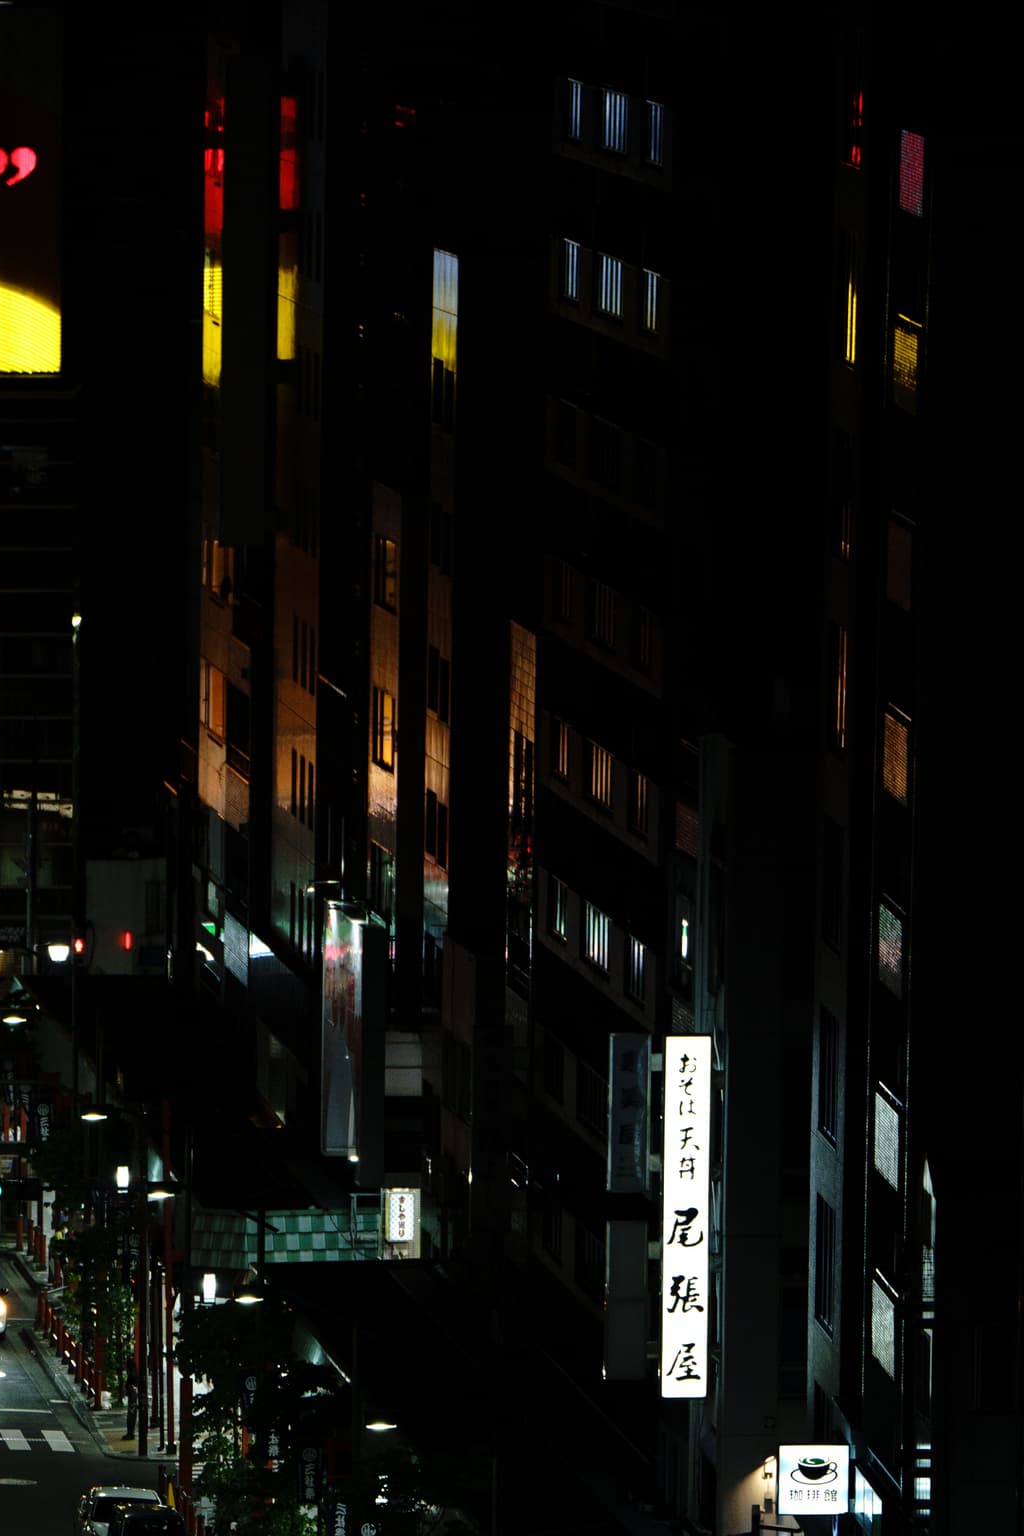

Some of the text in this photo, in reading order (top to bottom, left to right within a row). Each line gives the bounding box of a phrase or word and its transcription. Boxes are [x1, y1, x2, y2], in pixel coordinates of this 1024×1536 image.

[667, 1207, 704, 1381] 尾張屋
[790, 1490, 838, 1502] 珈琲館
